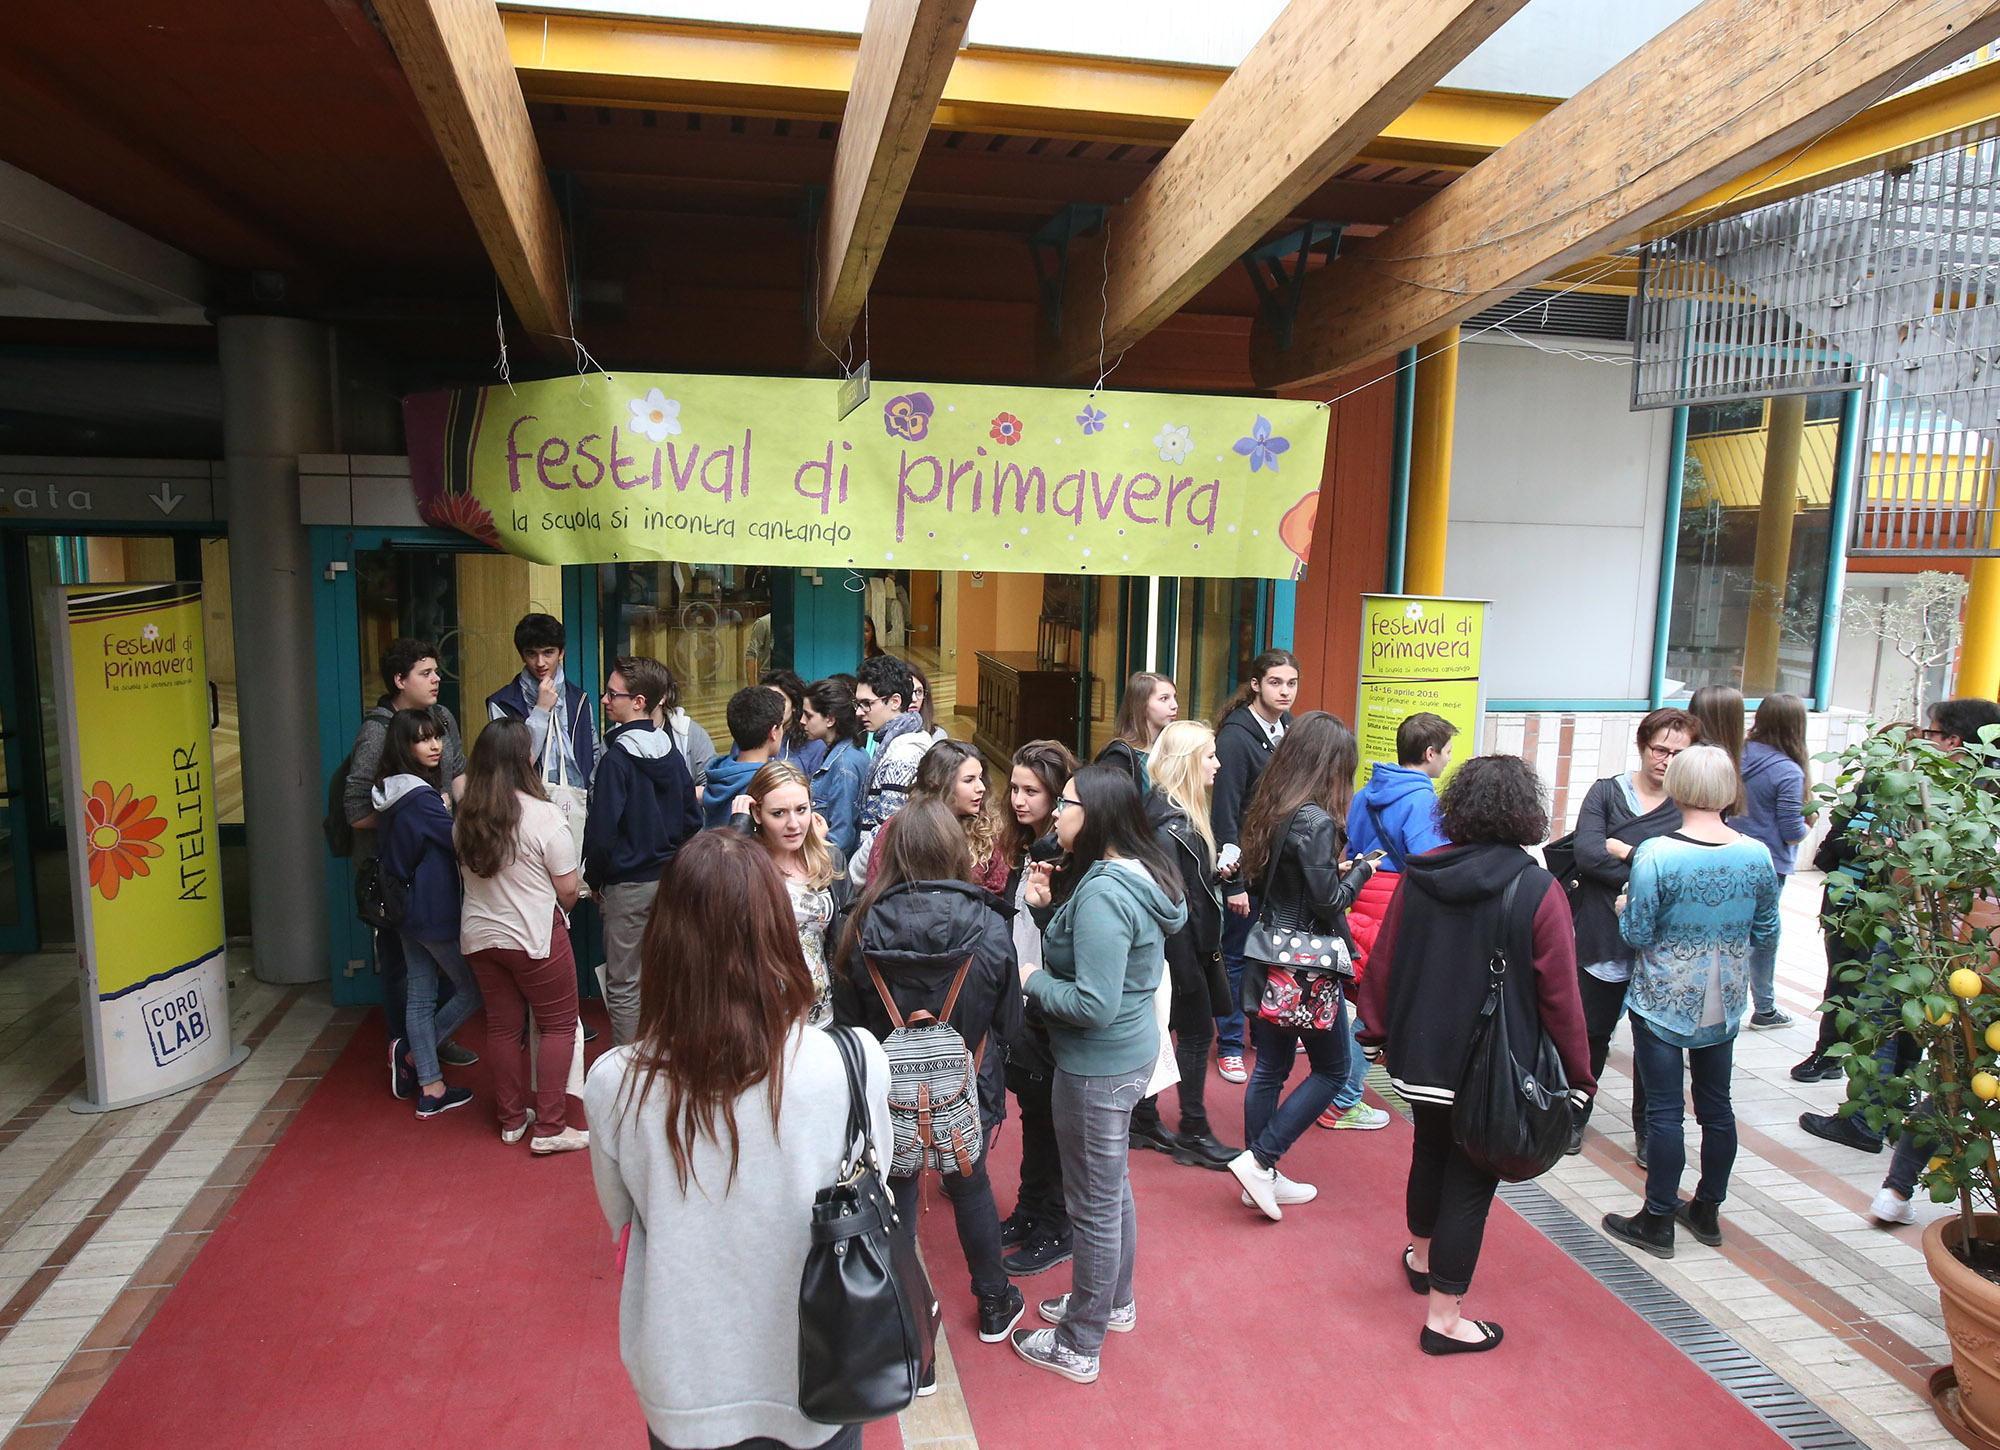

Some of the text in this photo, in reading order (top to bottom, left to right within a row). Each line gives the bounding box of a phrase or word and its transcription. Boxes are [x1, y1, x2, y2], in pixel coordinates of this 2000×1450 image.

[505, 415, 1221, 543] festival di primavera
[0, 484, 93, 511] ata
[512, 506, 852, 547] la scuola si incontra cantando
[1372, 612, 1472, 637] festival di
[104, 632, 192, 656] festival di
[1371, 638, 1470, 669] primavera
[105, 656, 193, 689] primavera
[1394, 687, 1415, 697] aprile
[1416, 689, 1439, 698] 2016
[173, 742, 208, 901] ATELIER
[151, 989, 198, 1028] CORO
[157, 1011, 205, 1057] LAB
